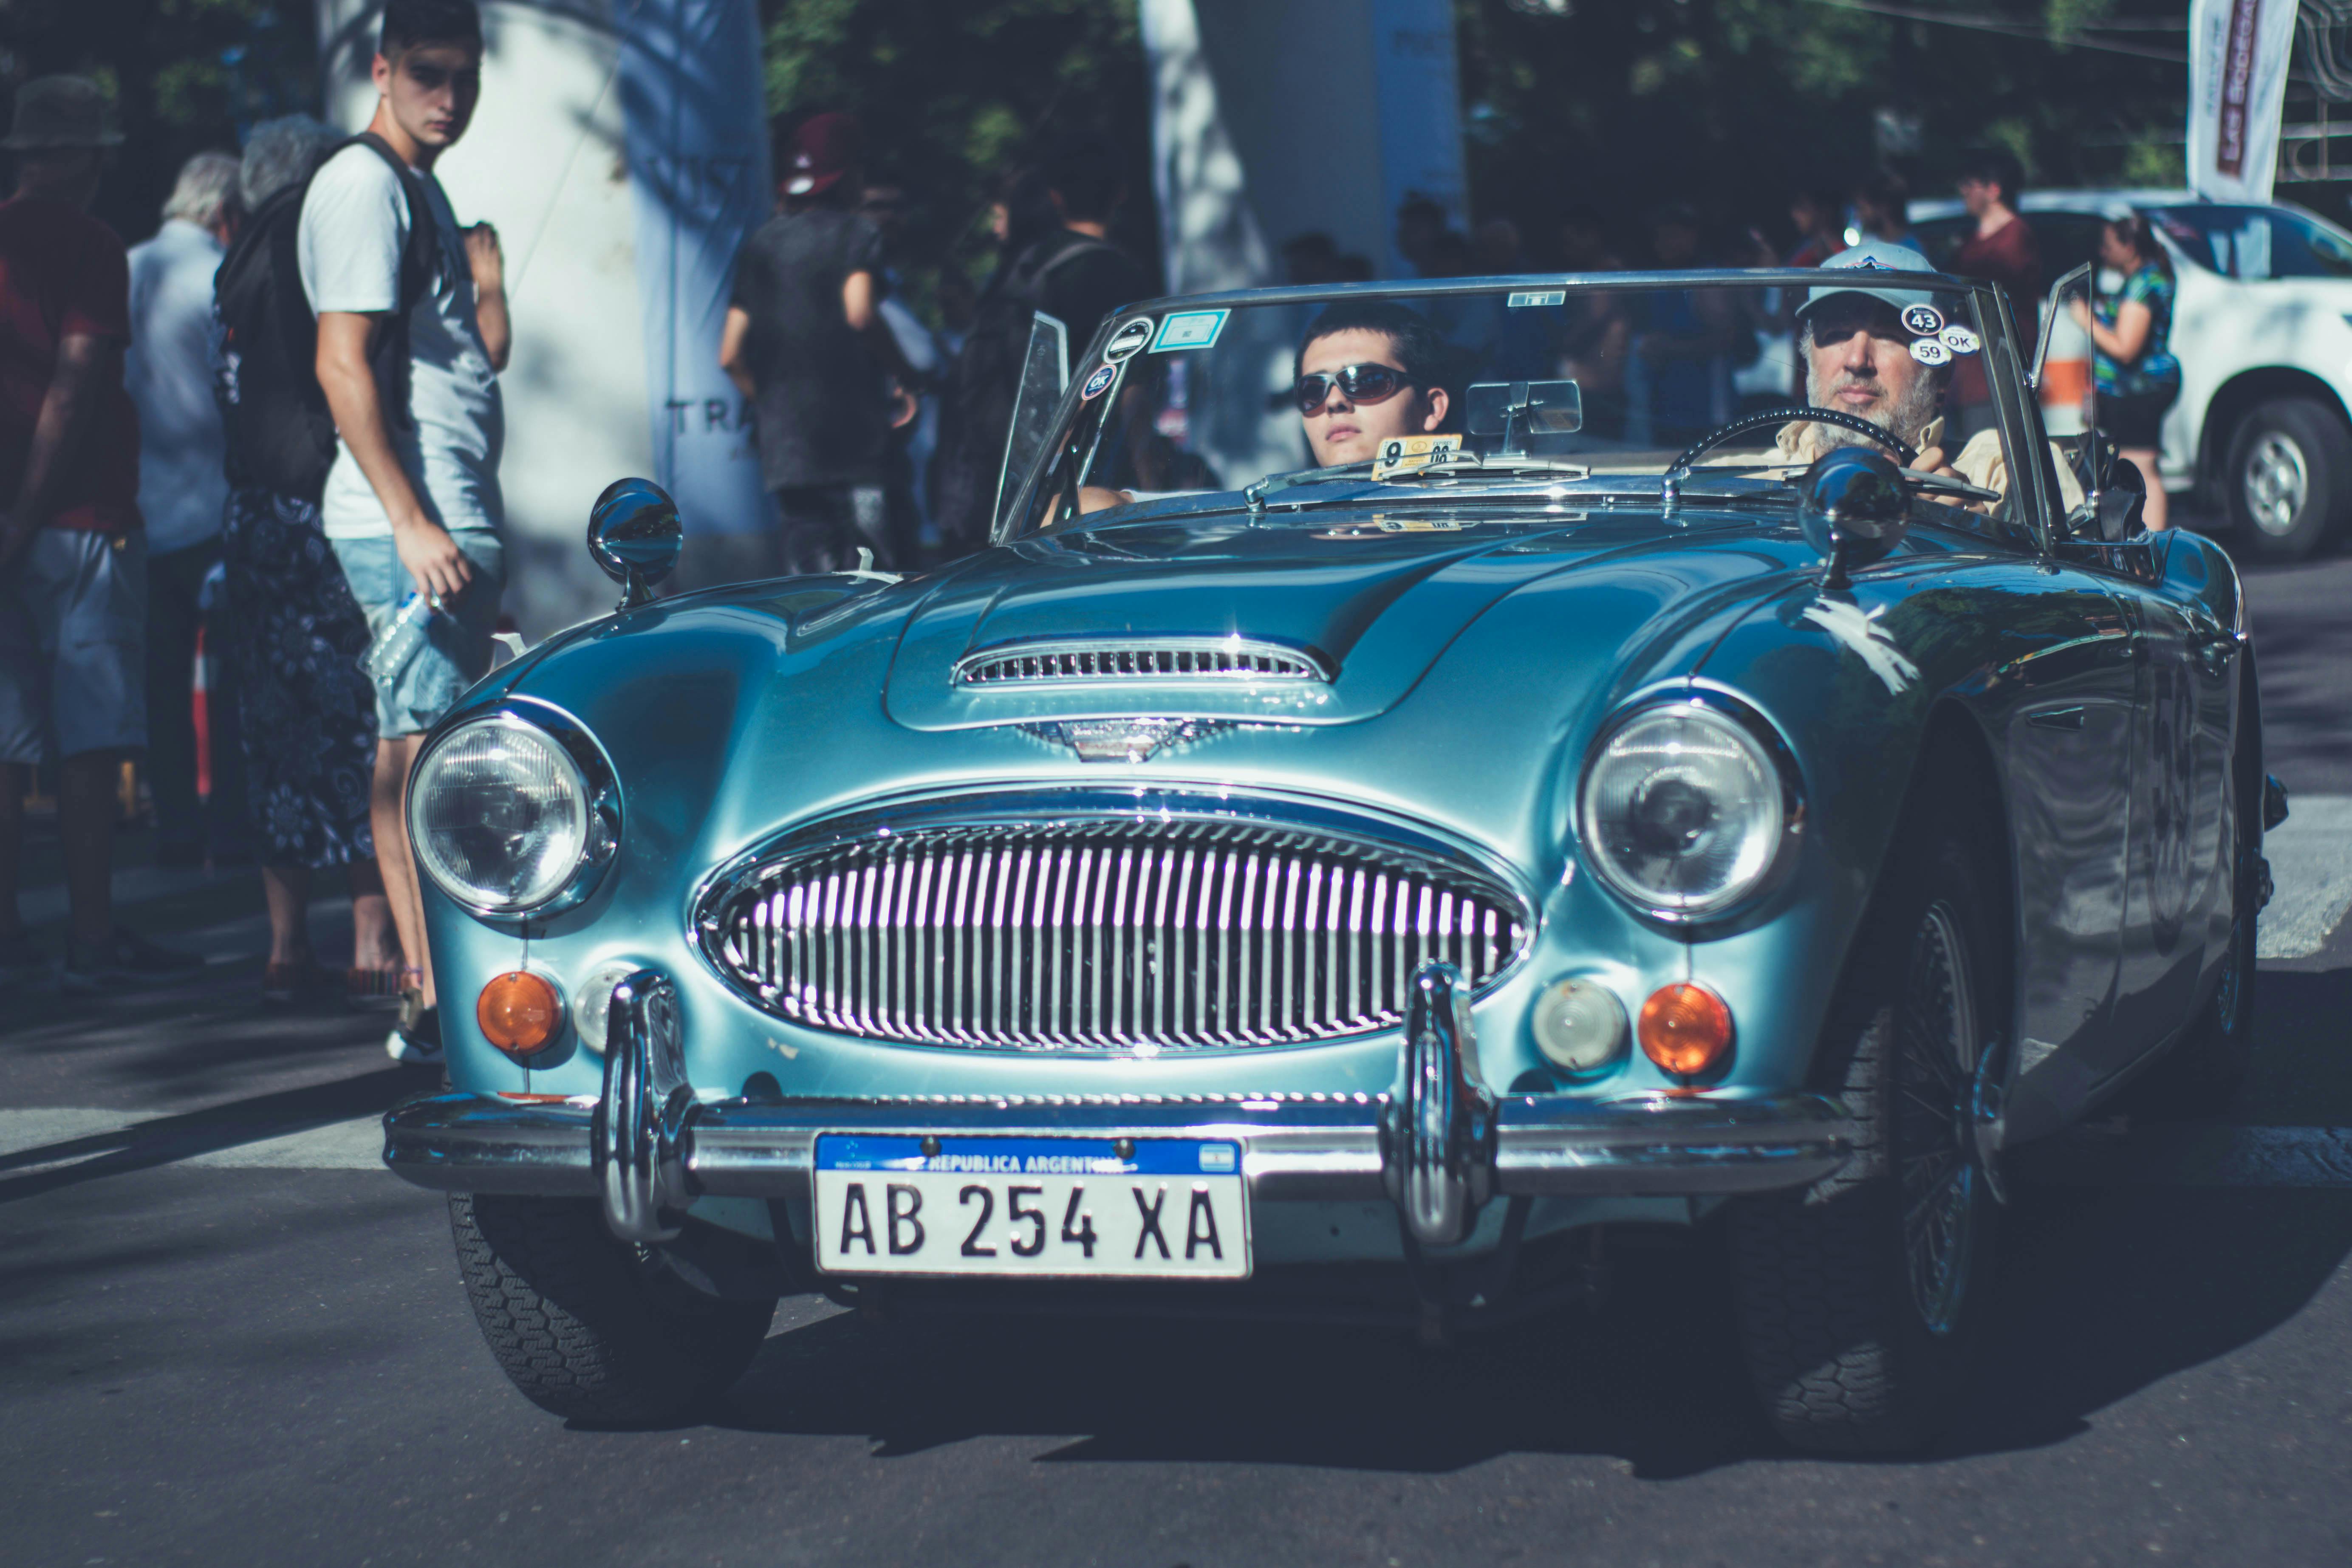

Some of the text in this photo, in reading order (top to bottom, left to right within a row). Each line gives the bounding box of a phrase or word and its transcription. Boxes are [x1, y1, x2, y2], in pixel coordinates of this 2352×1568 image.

[2227, 0, 2257, 105] BODEGA
[1911, 314, 1936, 328] 43
[1948, 336, 1971, 348] OK
[1919, 346, 1941, 359] 59
[1090, 375, 1109, 388] OK
[1384, 442, 1402, 468] 9
[929, 1154, 1021, 1172] REPUBLICA
[840, 1182, 1224, 1260] AB 254 XA
